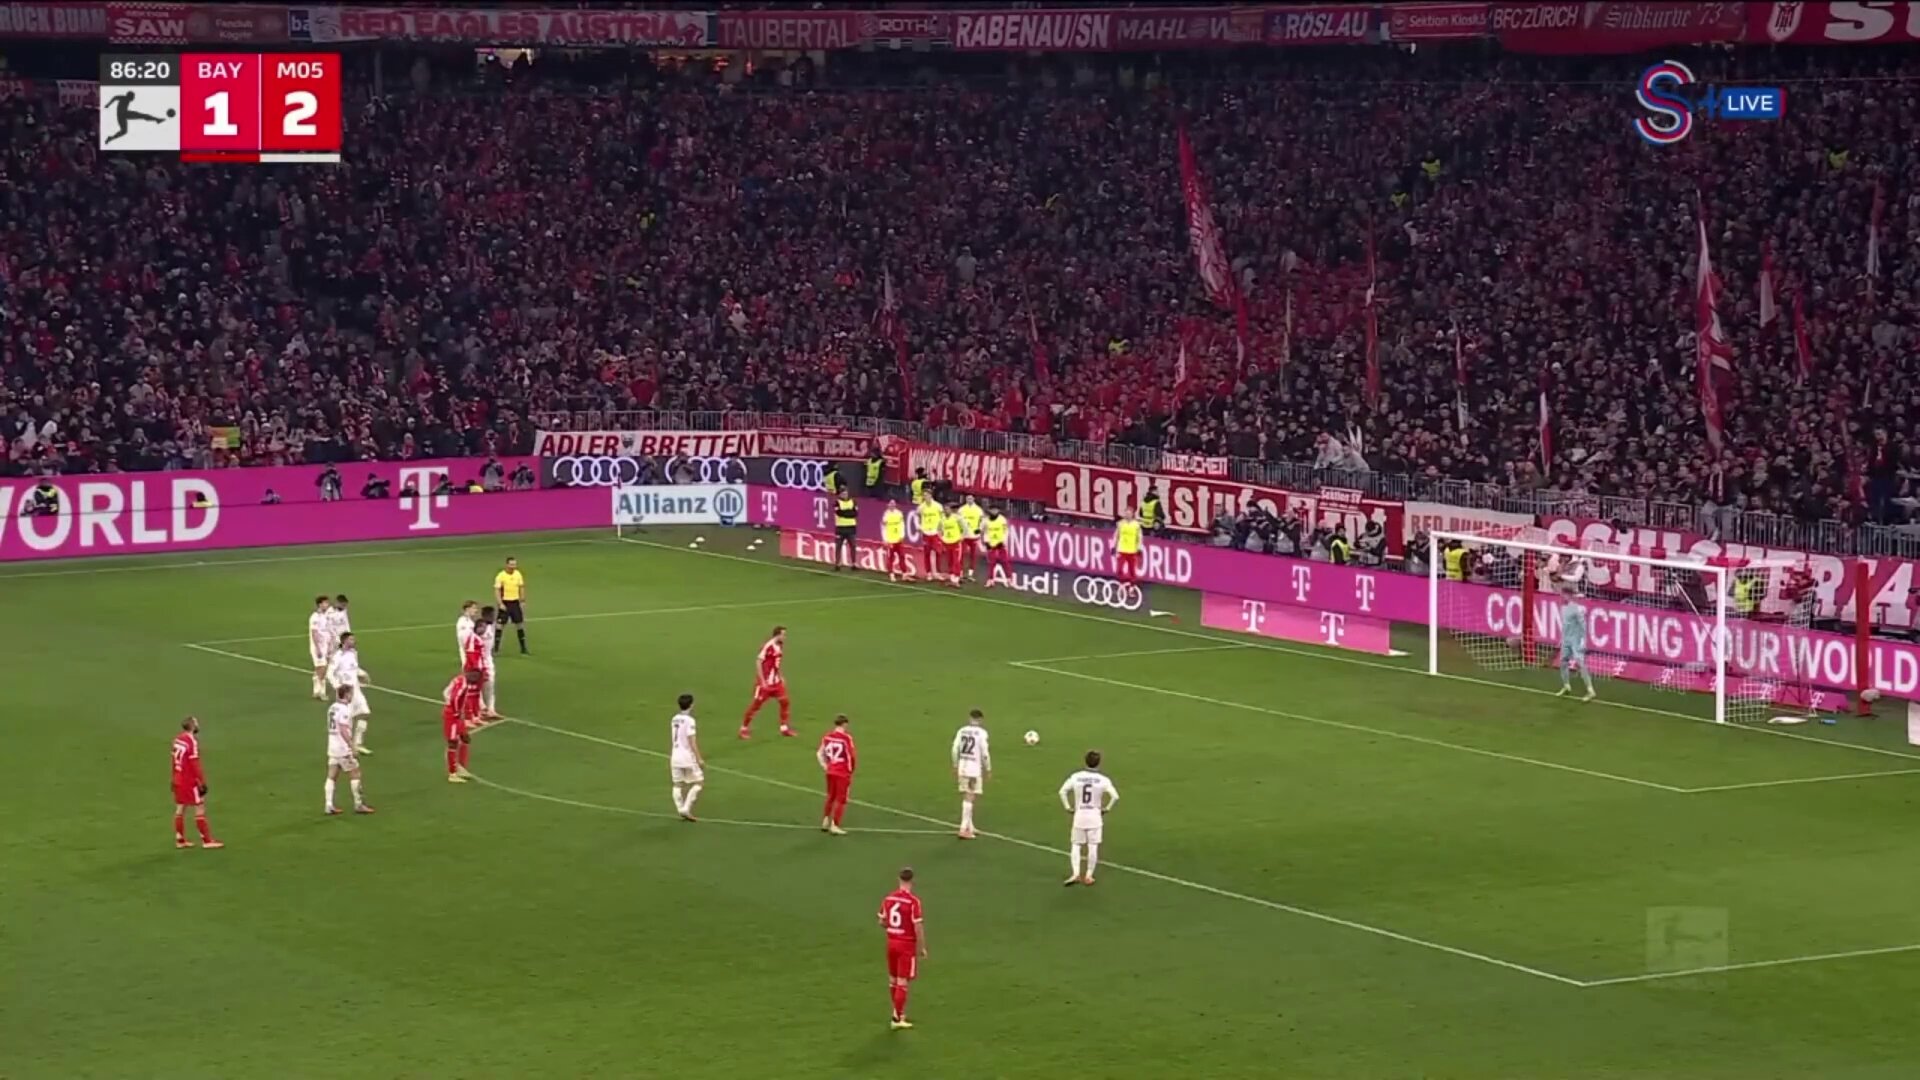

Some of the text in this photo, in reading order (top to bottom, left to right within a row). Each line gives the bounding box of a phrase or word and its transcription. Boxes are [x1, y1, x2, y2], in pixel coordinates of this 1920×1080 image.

[115, 17, 184, 37] SAW
[341, 12, 682, 40] RED EAGLES AUSTRIA
[879, 19, 927, 32] ROTH
[1285, 11, 1368, 39] RÖSLAU
[1409, 15, 1449, 28] Sektion
[1494, 5, 1578, 29] BFC ZÜRICH
[1824, 0, 1920, 41] S
[719, 18, 849, 48] TAUBERTAL
[955, 14, 1110, 48] RABENAU/SN
[541, 434, 620, 458] ADLER
[640, 433, 757, 458] BRETTEN
[0, 478, 221, 551] ORLD
[616, 492, 708, 516] Allianz
[1045, 529, 1105, 572] YOUR
[1108, 540, 1193, 584] ORLD
[992, 563, 1060, 597] Audi
[1486, 592, 1683, 659] CONNCTING
[1689, 620, 1781, 674] YOUR
[961, 735, 976, 756] 22
[1082, 784, 1092, 804] 6
[888, 902, 901, 928] 6
